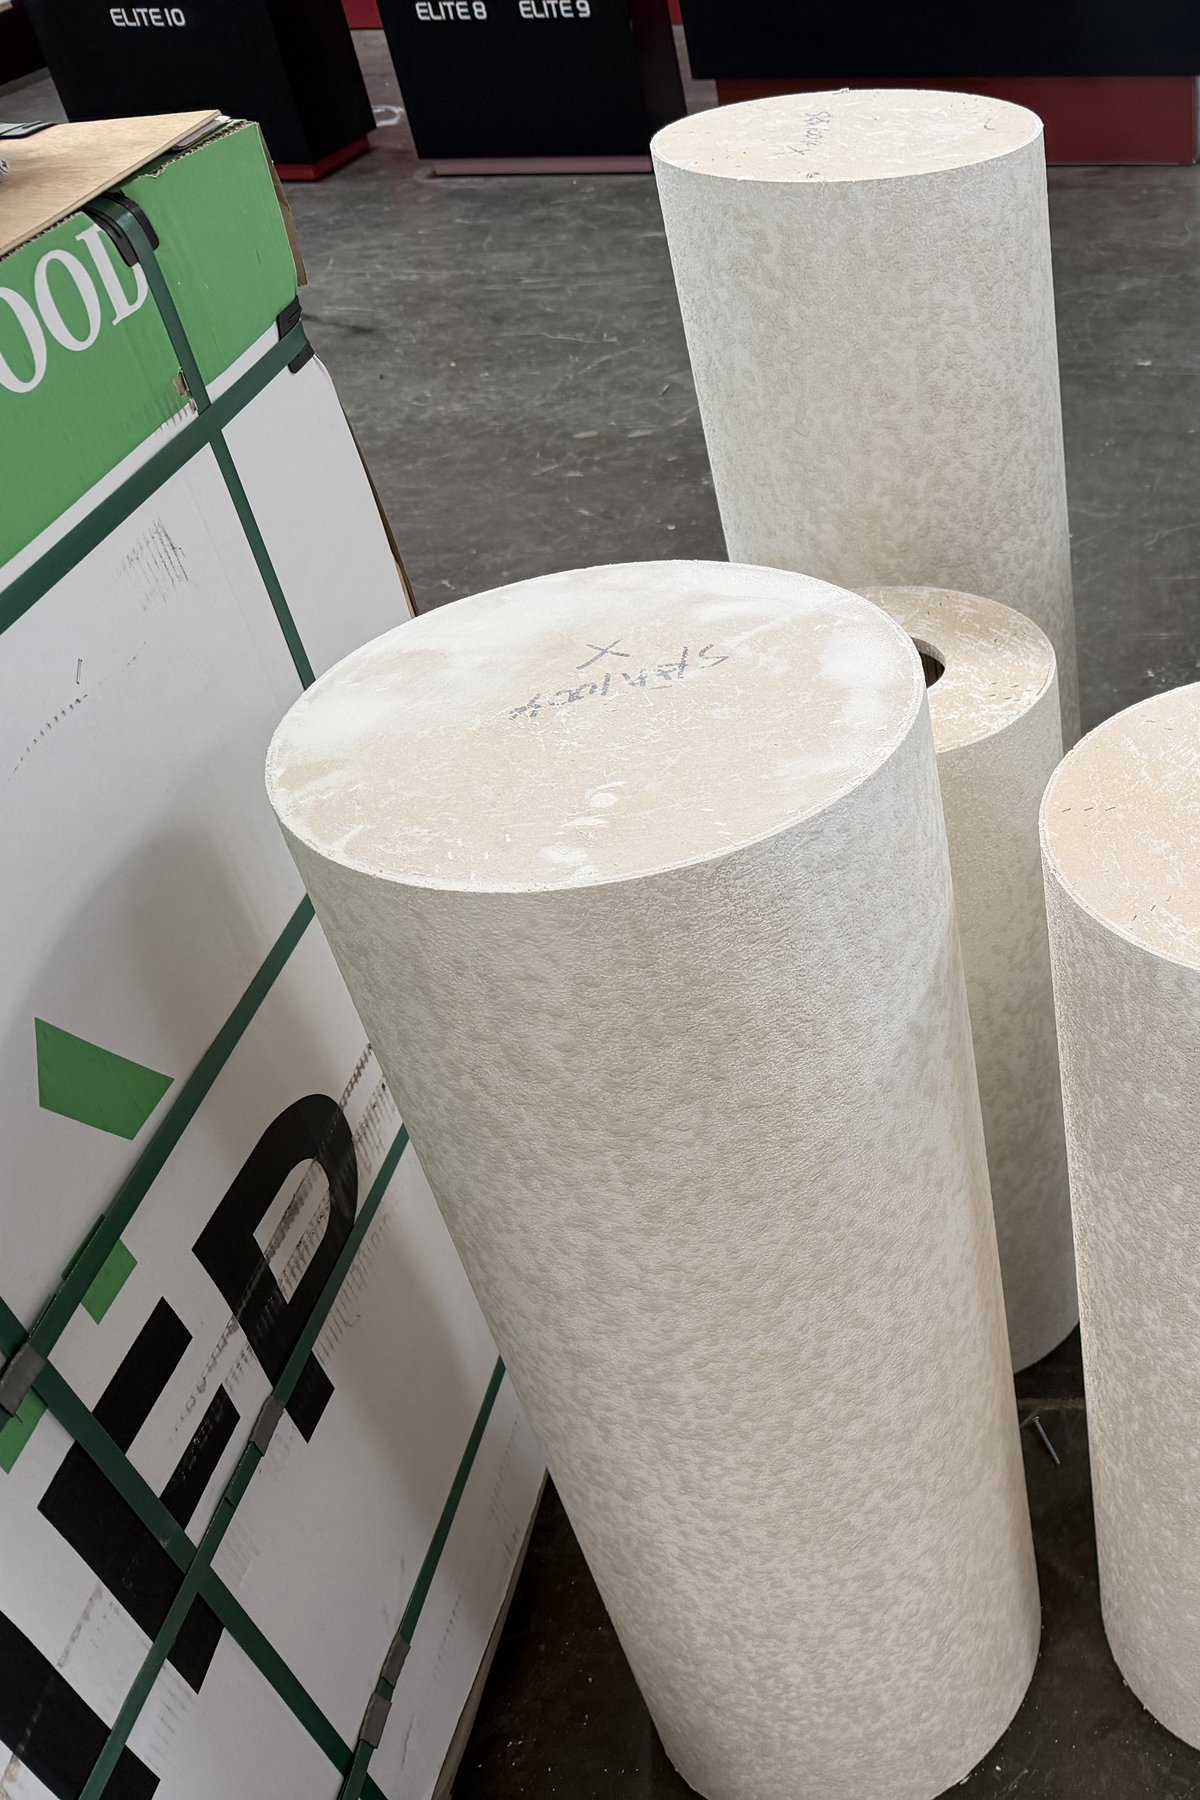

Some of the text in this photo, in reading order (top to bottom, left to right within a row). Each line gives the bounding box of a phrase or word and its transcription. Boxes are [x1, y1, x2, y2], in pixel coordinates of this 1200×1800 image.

[109, 7, 166, 27] ELITE
[415, 1, 488, 21] ELITE 8
[518, 0, 591, 19] ELITE 9
